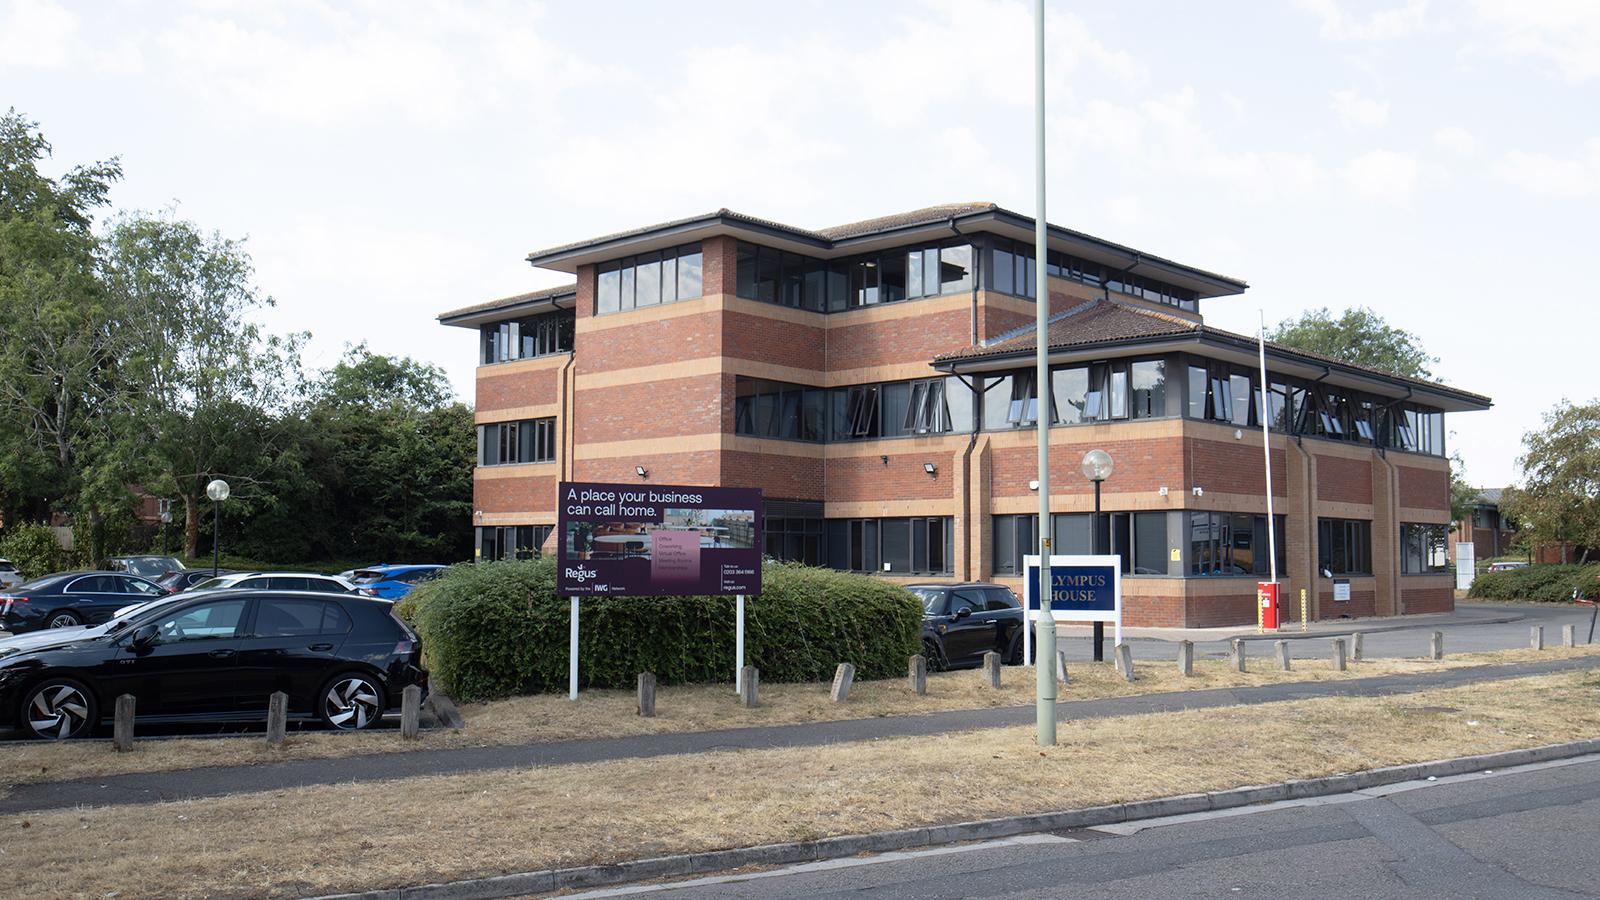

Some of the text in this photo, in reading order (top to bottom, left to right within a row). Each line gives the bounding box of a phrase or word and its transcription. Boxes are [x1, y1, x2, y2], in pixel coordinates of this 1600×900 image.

[567, 488, 702, 505] A place your business
[567, 504, 657, 517] can call home.
[565, 568, 596, 582] Regus
[1051, 575, 1105, 586] LYMPUS
[594, 584, 608, 592] IWG
[1051, 590, 1096, 601] HOUSE
